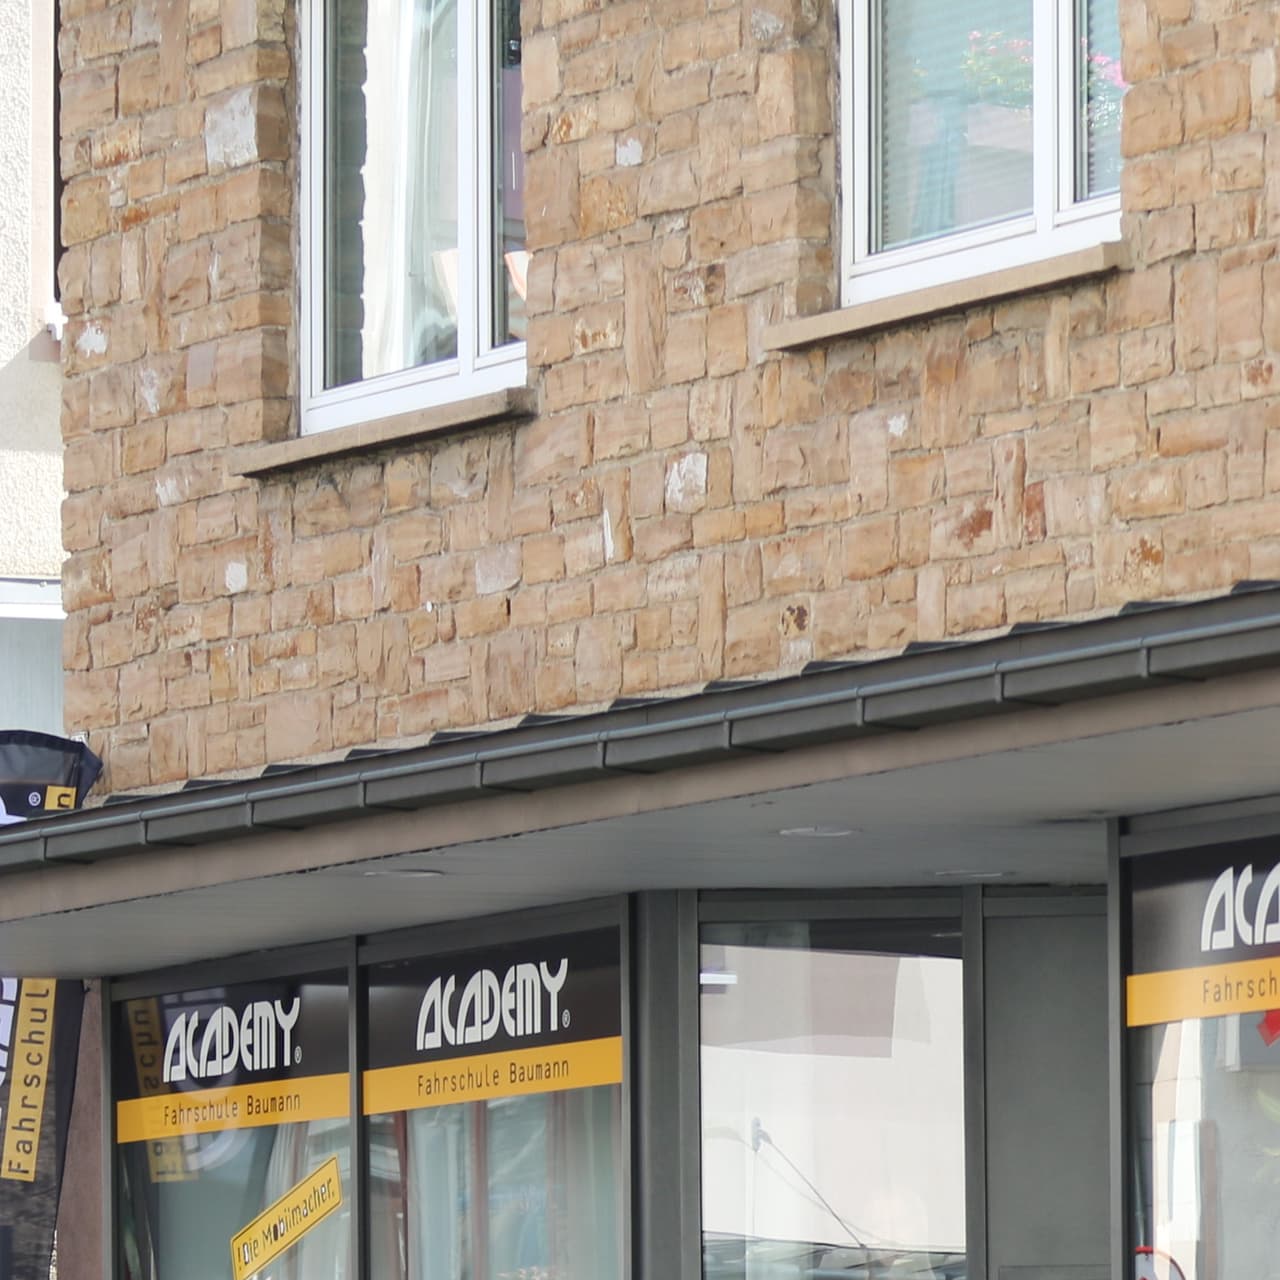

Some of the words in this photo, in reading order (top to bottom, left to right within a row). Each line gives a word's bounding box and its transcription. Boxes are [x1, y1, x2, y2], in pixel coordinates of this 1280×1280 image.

[8, 988, 49, 1175] Fahrschul
[417, 1066, 500, 1096] Fahrschule
[509, 1060, 569, 1084] Baumann
[164, 1099, 239, 1127] Fahrschule
[247, 1093, 300, 1116] Baumann
